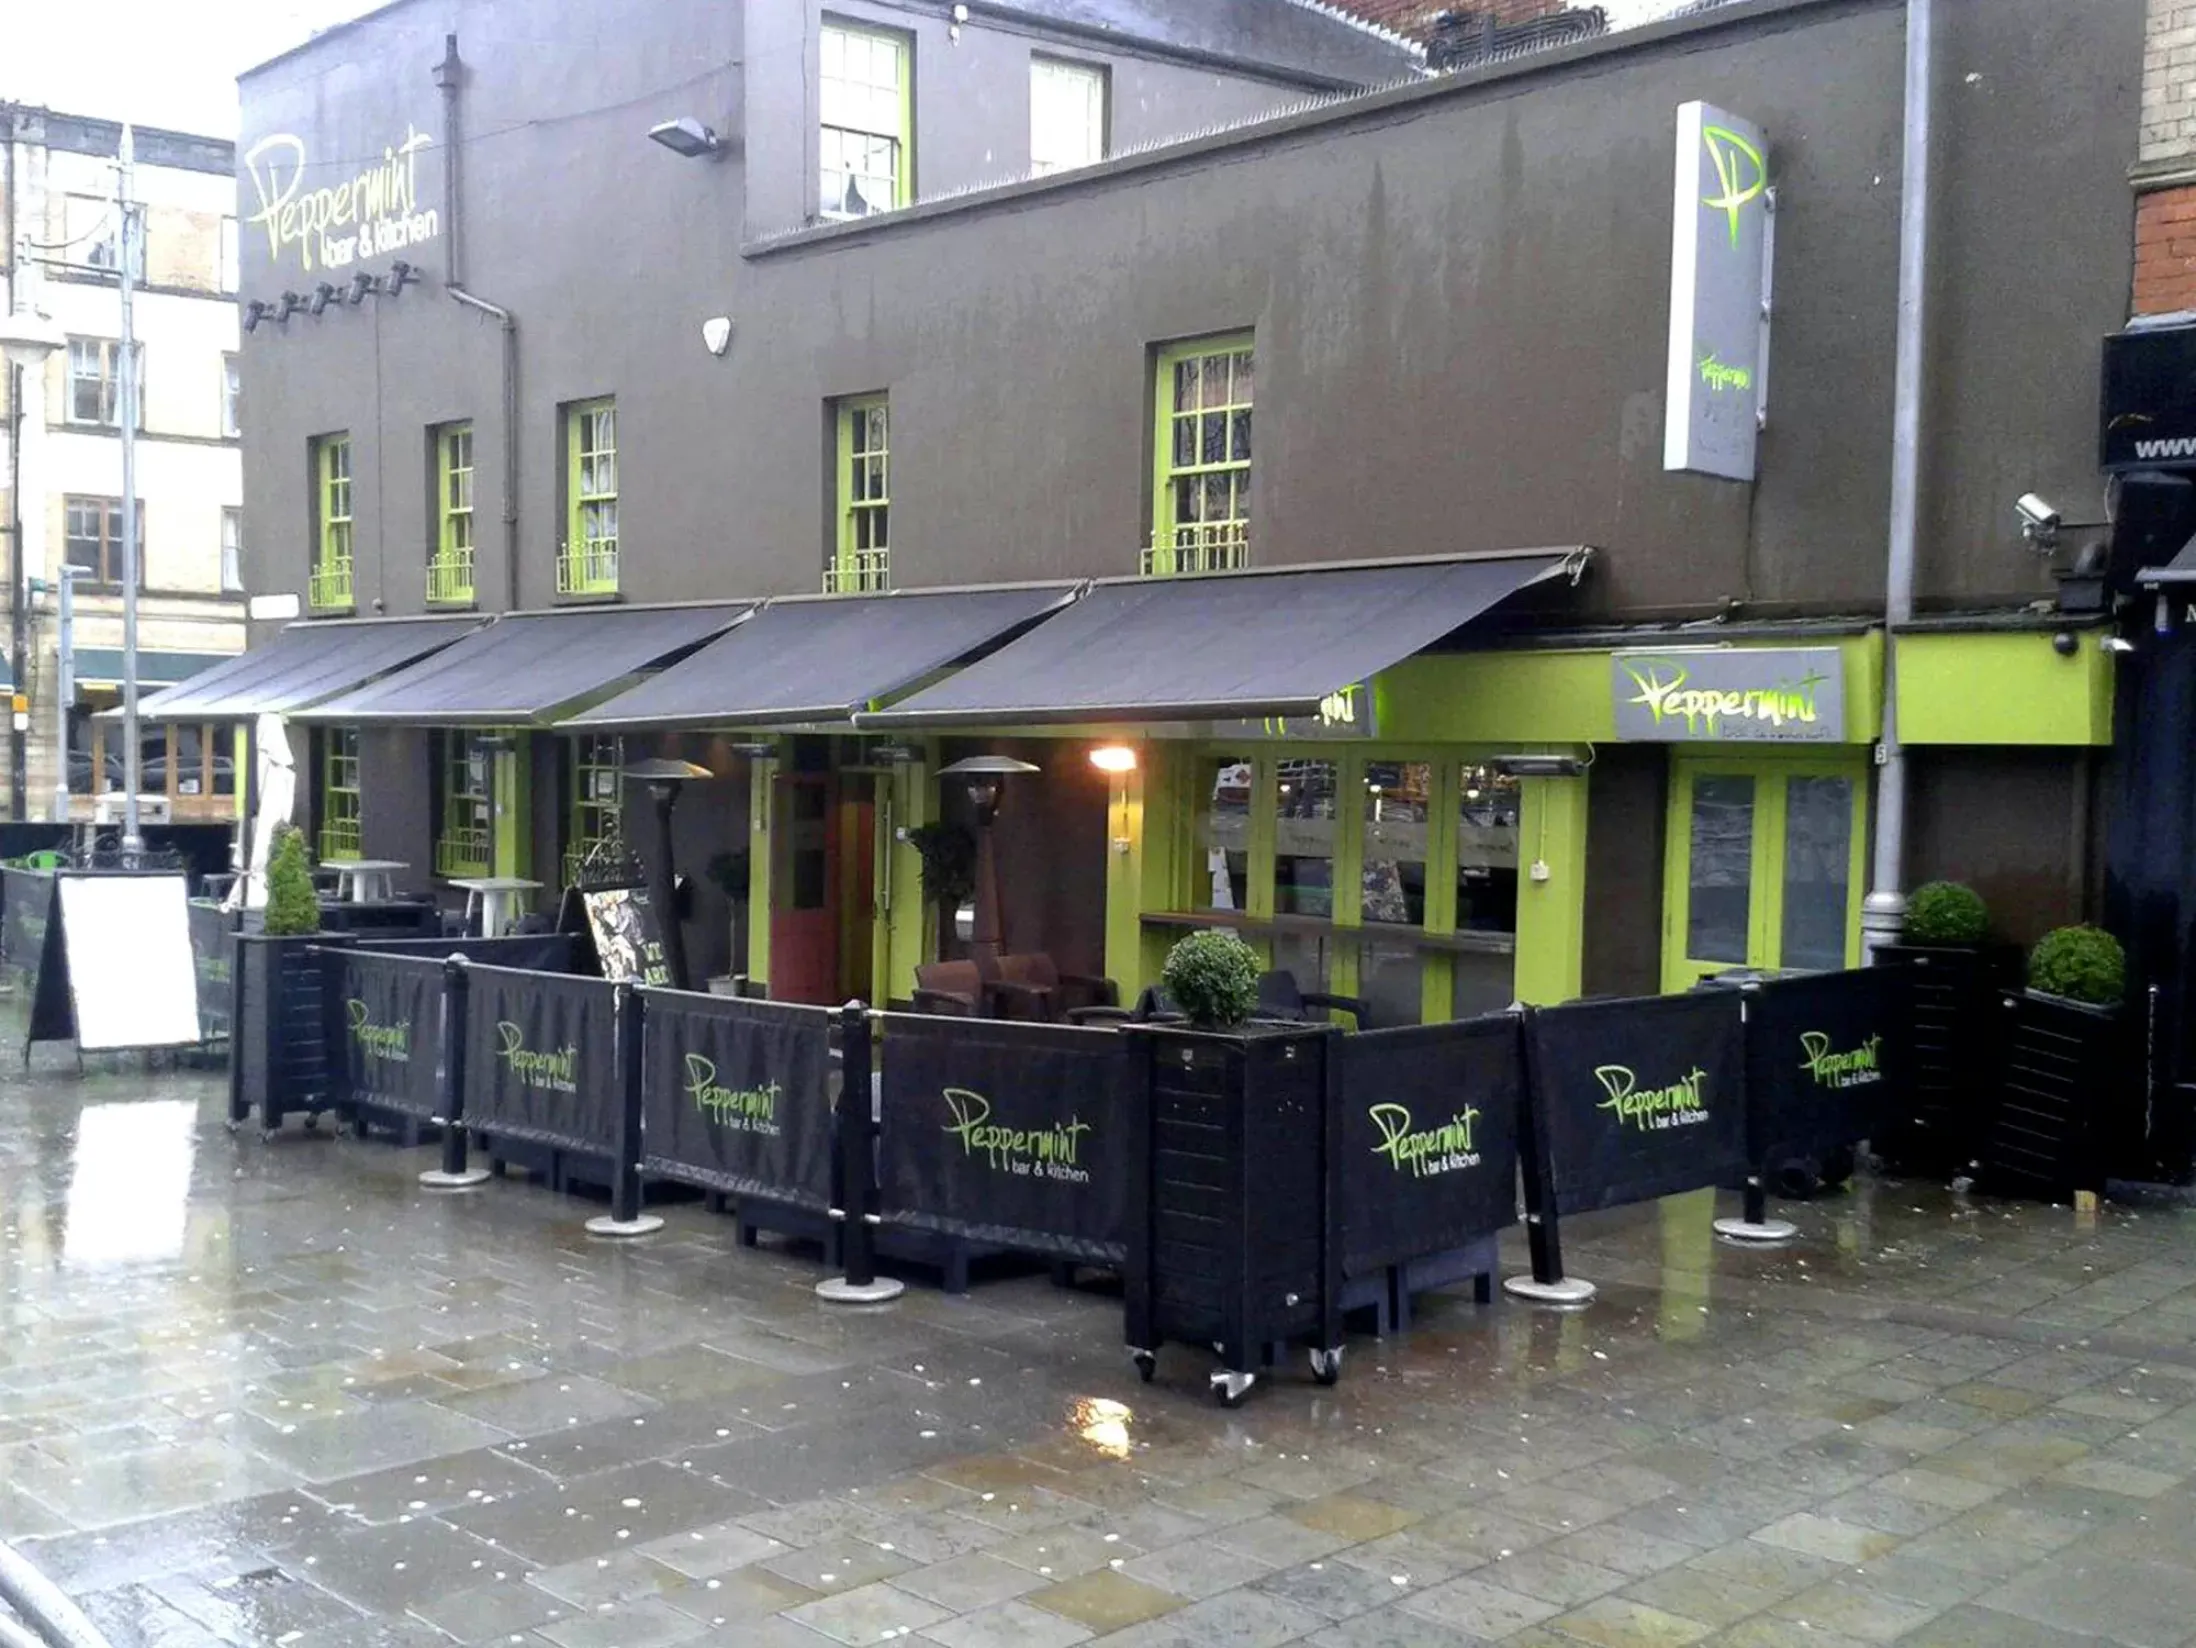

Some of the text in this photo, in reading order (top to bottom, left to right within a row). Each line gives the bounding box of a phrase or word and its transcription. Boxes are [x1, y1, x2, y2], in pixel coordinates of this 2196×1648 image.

[245, 122, 433, 271] Peppermint
[323, 208, 439, 269] bar & kitchen
[1617, 655, 1831, 737] Peppermint
[496, 1020, 577, 1085] Peppermint
[1798, 1031, 1883, 1088] Peppermint
[683, 1053, 782, 1125] Peppermint
[1594, 1065, 1708, 1131] Peppermint
[940, 1087, 1092, 1173] Peppermint
[1369, 1102, 1480, 1178] Peppermint
[1011, 1157, 1091, 1183] bar & kitchen
